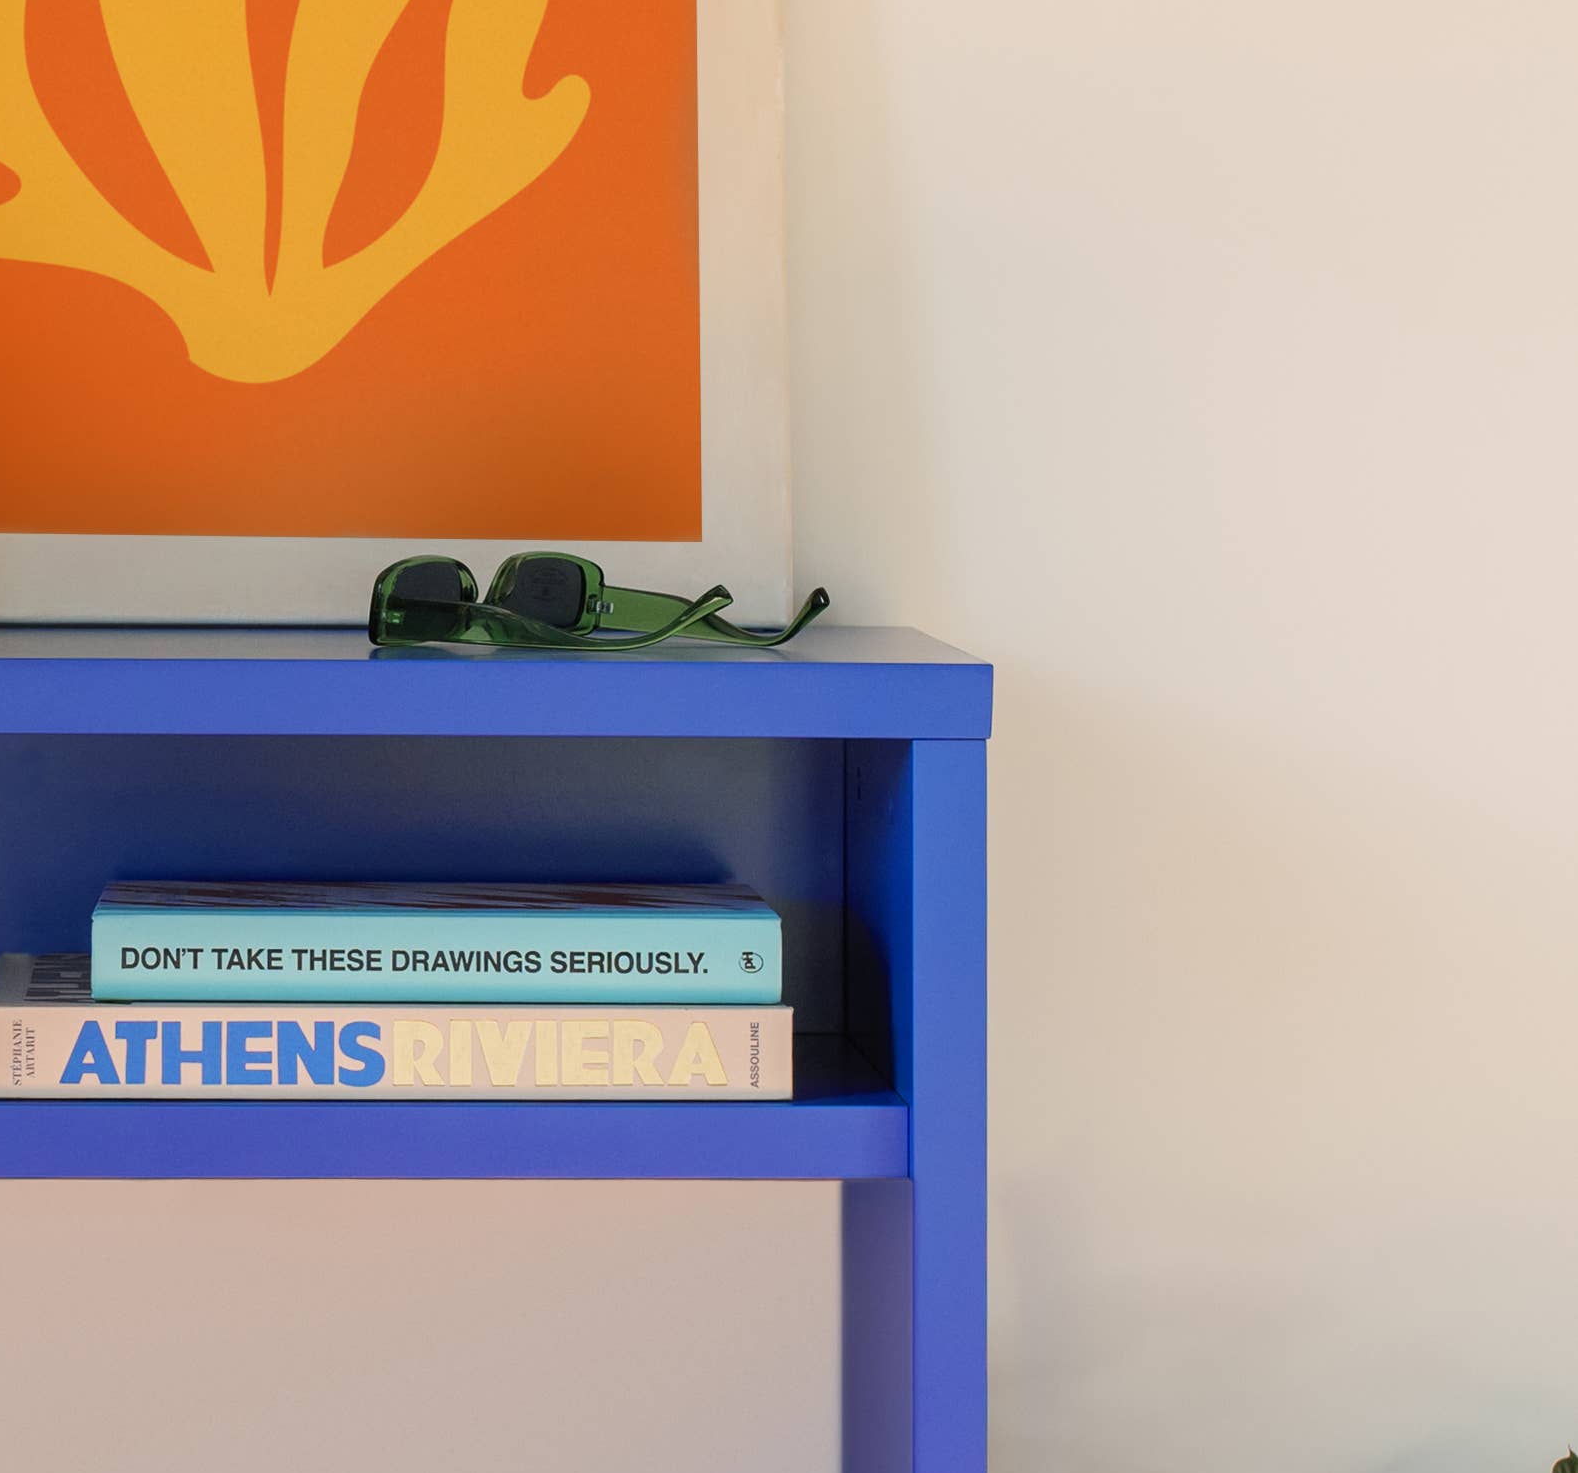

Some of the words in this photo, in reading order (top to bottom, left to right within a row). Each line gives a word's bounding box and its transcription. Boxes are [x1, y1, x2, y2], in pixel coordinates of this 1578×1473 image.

[210, 947, 284, 970] TAKE
[291, 948, 383, 972] THESE
[391, 949, 542, 973] DRAWINGS
[549, 951, 709, 975] SERIOUSLY.
[10, 1019, 23, 1087] STÉPHANIE
[25, 1027, 36, 1078] ARTARIT
[59, 1020, 386, 1087] ATHENS
[392, 1019, 728, 1087] RIVIERA
[749, 1021, 760, 1089] ASSOULINE
